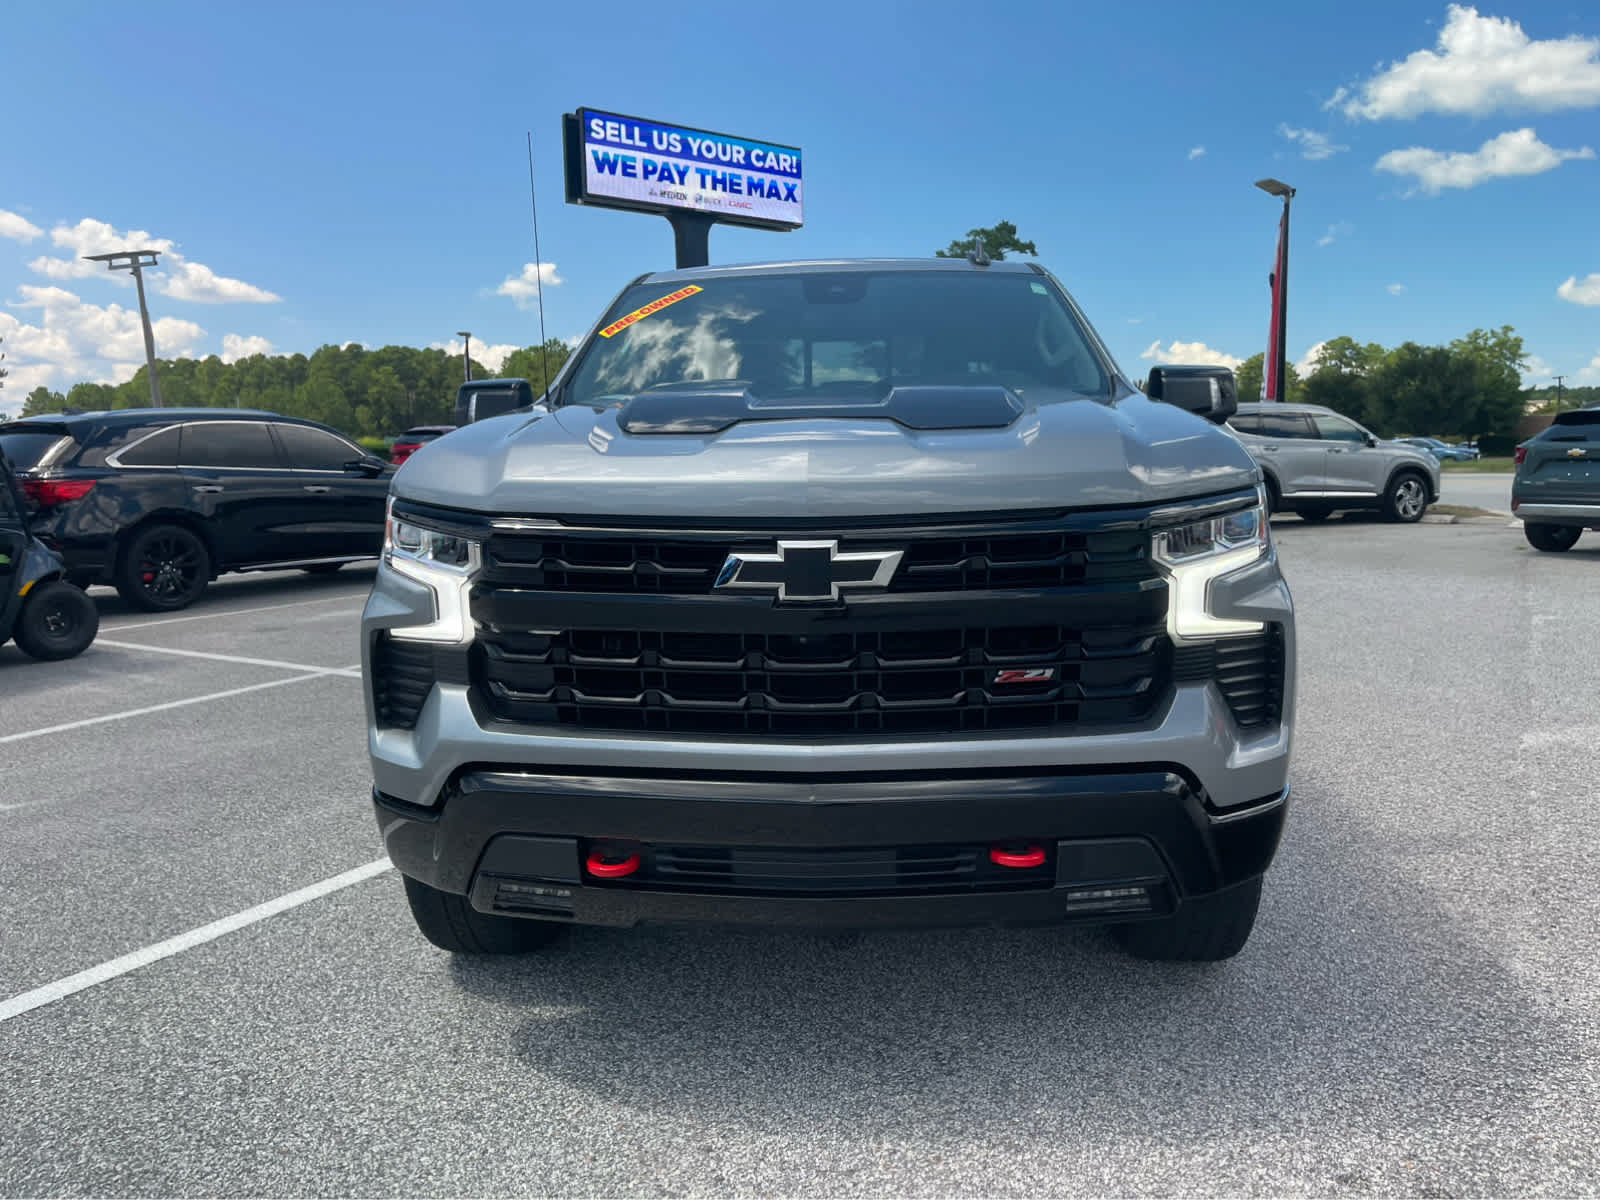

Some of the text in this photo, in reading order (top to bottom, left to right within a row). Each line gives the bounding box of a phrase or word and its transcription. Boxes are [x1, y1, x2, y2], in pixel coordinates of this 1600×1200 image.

[590, 118, 798, 174] SELL US YOUR CAR!
[591, 149, 638, 178] WE
[641, 158, 692, 186] PAY
[695, 168, 743, 195] THE
[747, 174, 799, 204] MAX
[728, 199, 753, 210] GMC
[604, 287, 697, 336] PRE-OWNED
[994, 667, 1055, 684] Z71
